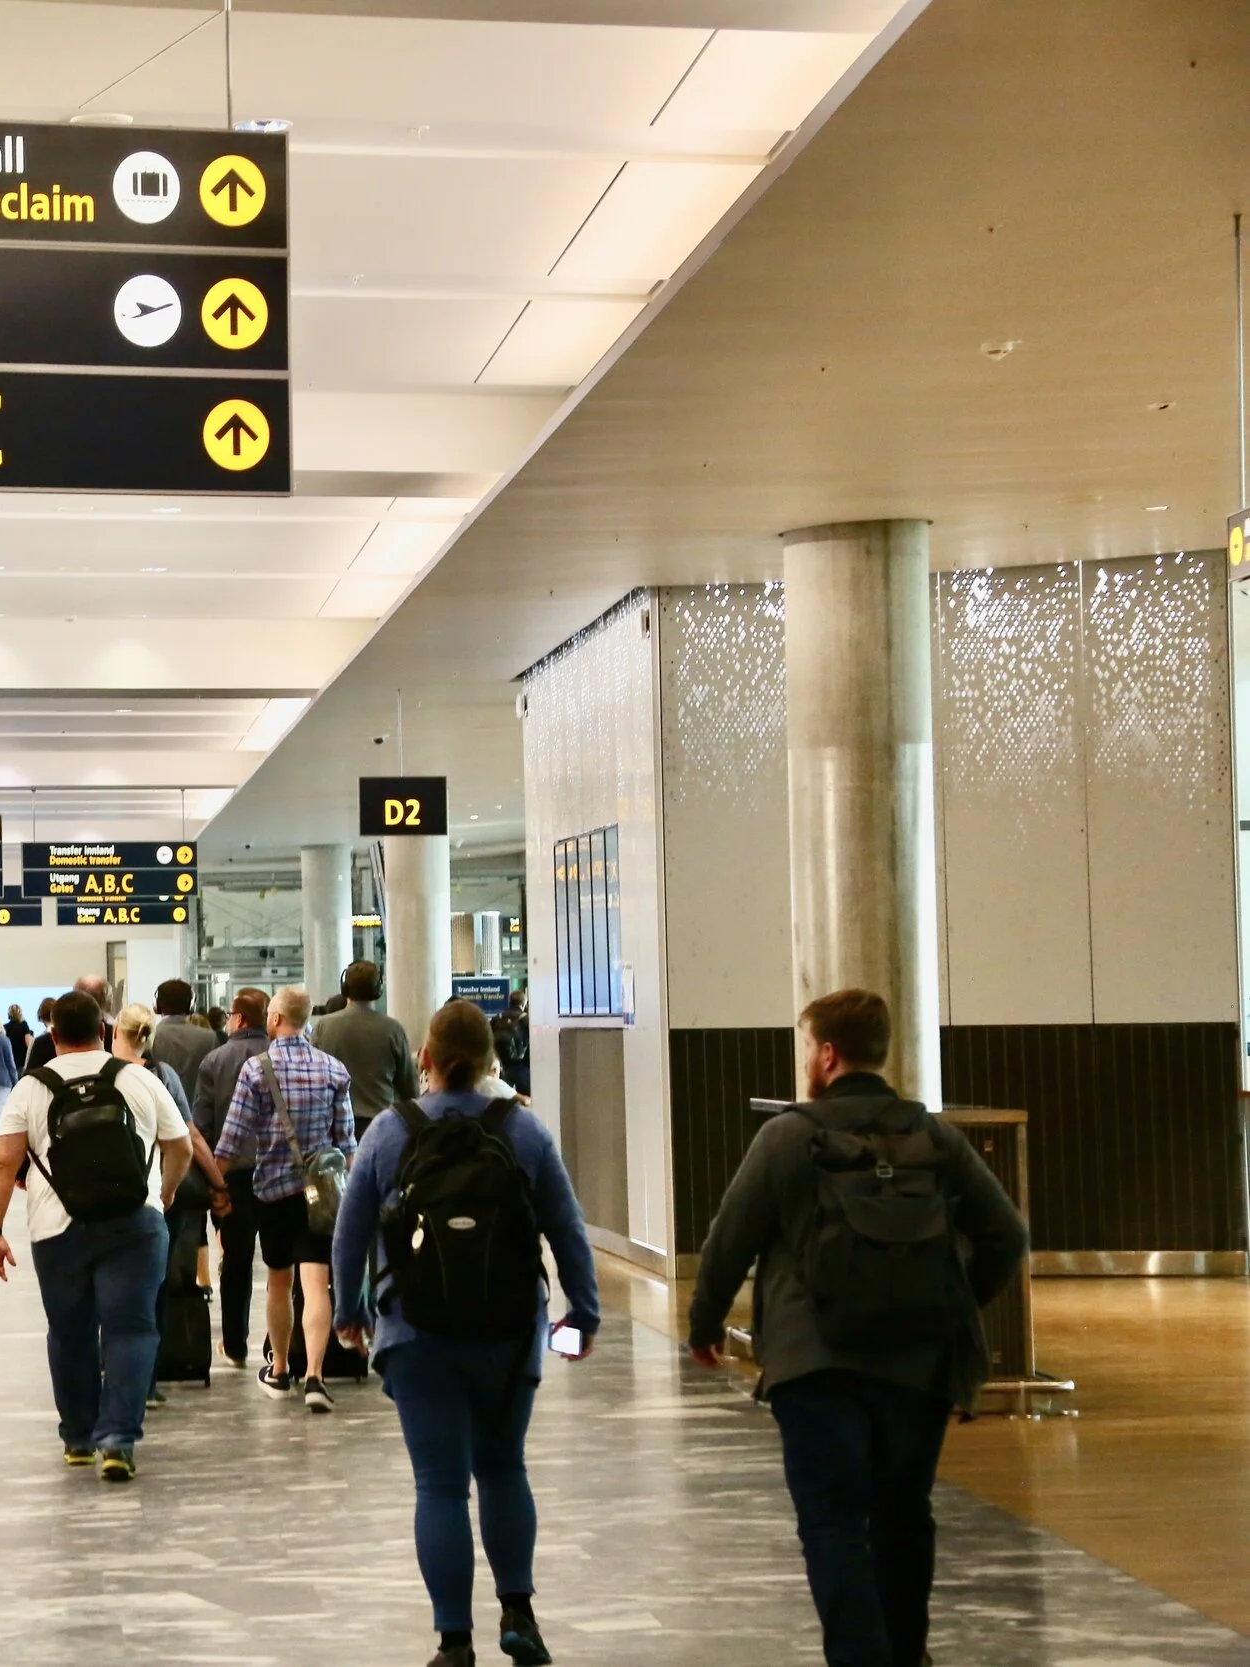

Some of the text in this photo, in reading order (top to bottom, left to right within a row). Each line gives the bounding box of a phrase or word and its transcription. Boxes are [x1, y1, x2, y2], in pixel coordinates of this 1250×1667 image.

[385, 799, 420, 825] D2
[50, 845, 82, 855] Transfer
[50, 855, 121, 865] Domestic transfer
[50, 873, 134, 894] Utgang A,B,C
[50, 884, 74, 894] Gates
[104, 907, 140, 924] A,B,C
